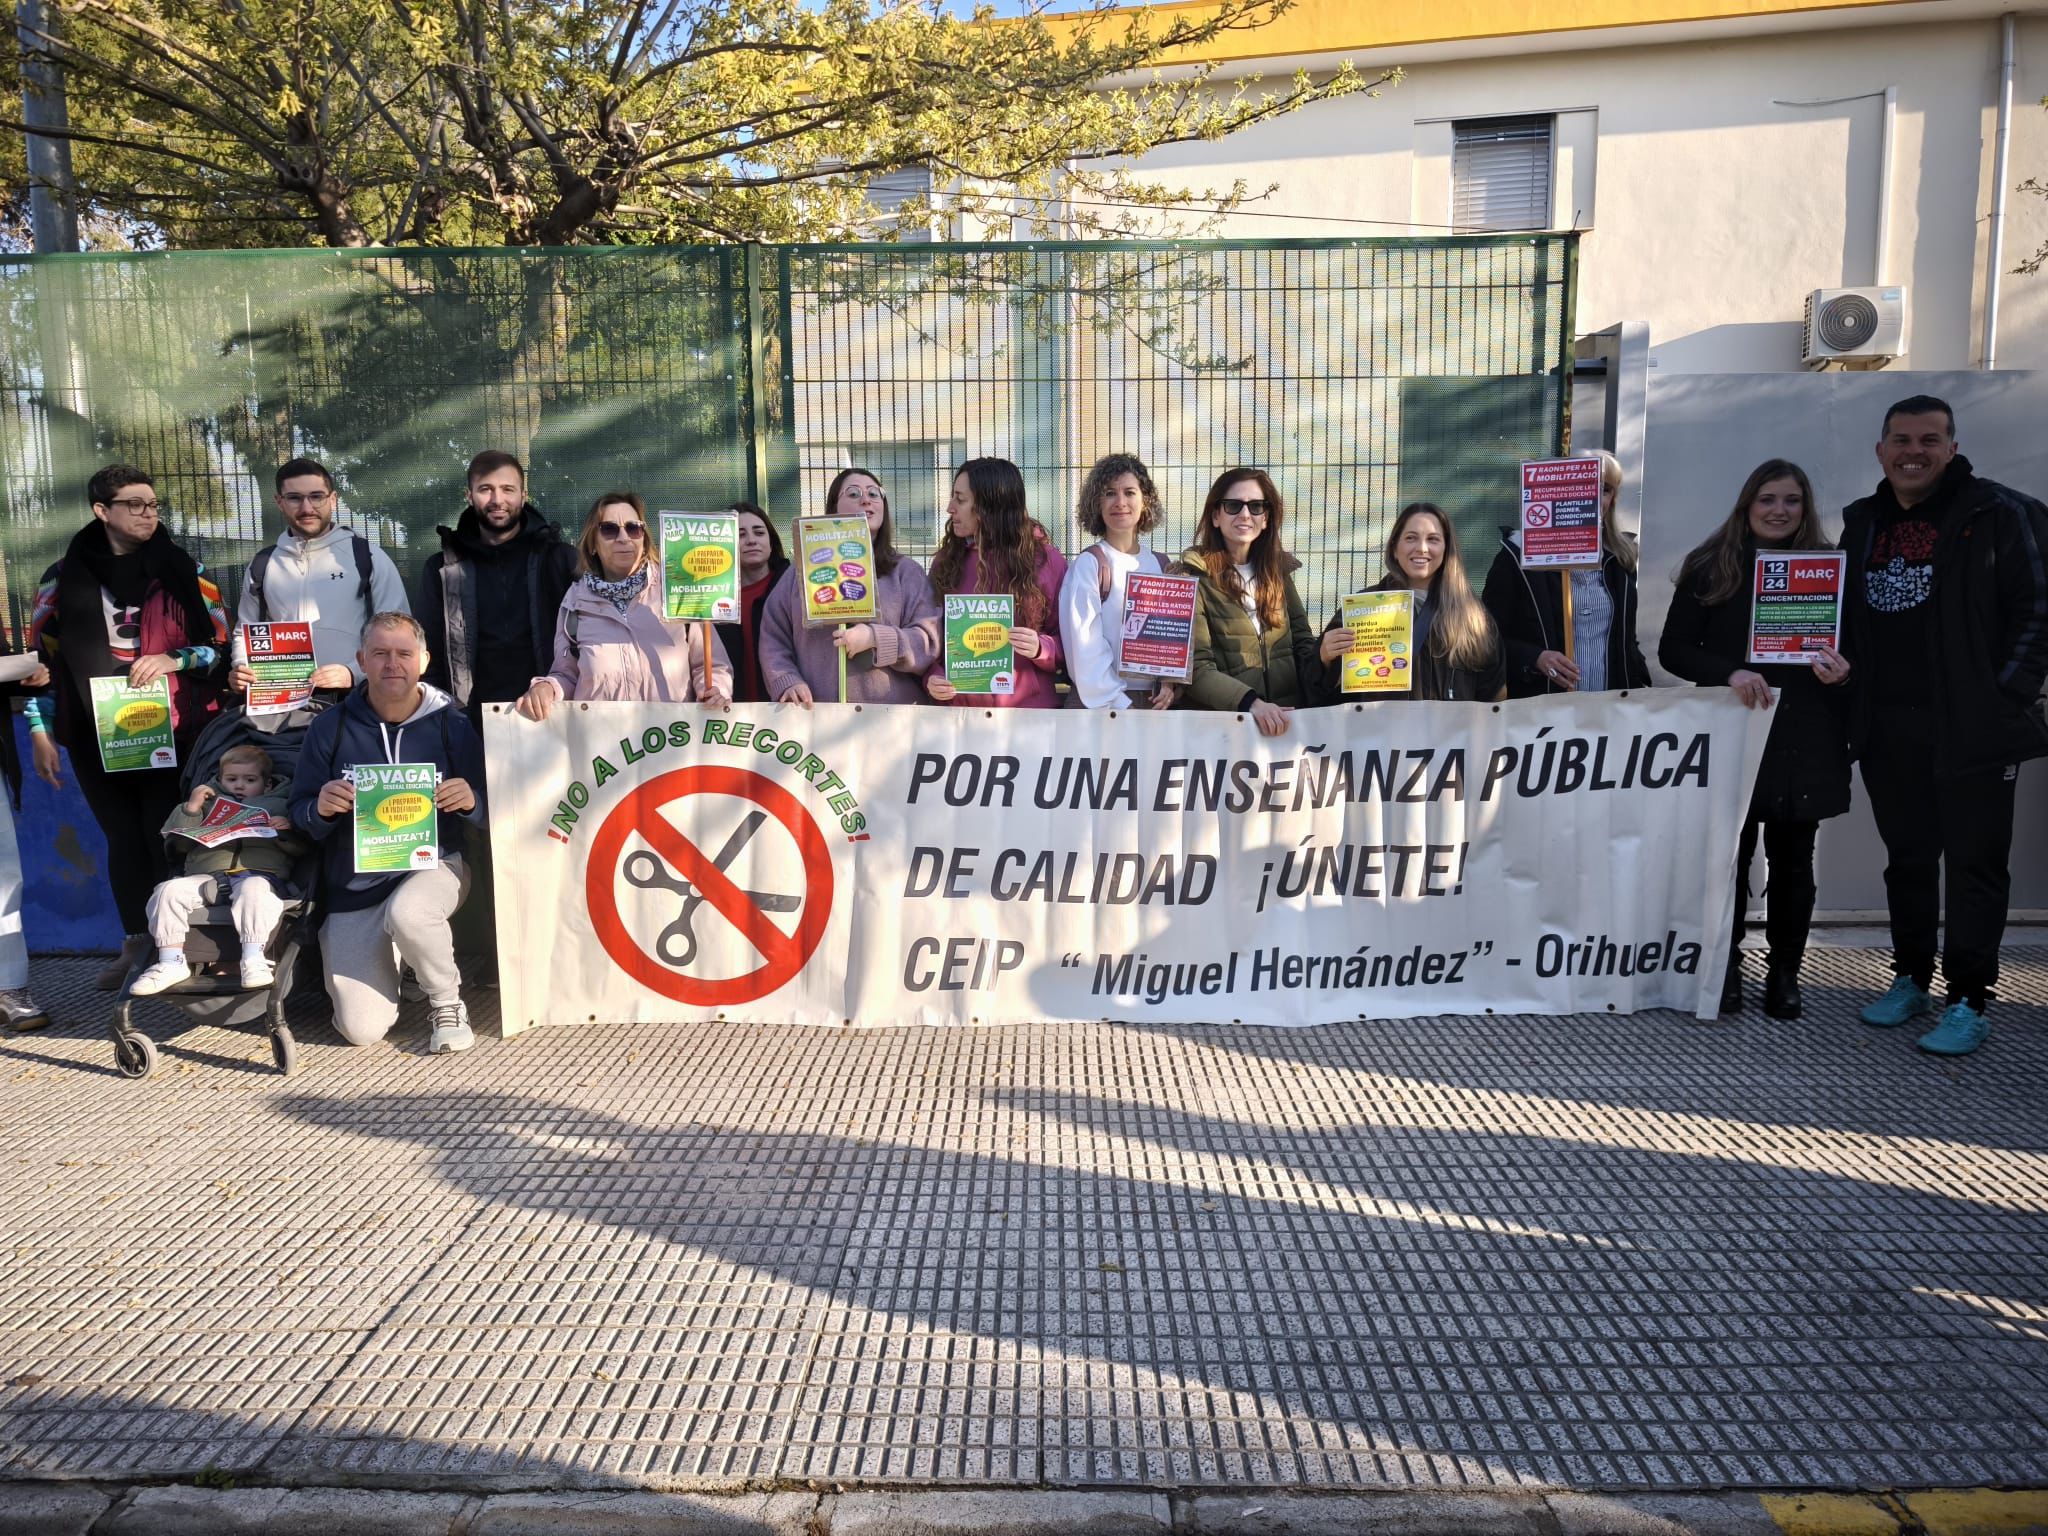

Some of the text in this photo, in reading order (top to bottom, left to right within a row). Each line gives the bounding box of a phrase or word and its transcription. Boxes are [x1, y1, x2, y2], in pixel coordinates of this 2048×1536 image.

[1526, 468, 1537, 482] 7
[1536, 469, 1598, 482] MOBILITZACIÓ
[1534, 492, 1568, 500] PLANTILLES
[1556, 512, 1596, 520] CONDICIONS
[664, 519, 680, 531] 31
[686, 522, 734, 537] VAGA
[697, 550, 724, 558] PREPAREM
[1768, 562, 1784, 573] 12
[1794, 569, 1835, 581] MARÇ
[1131, 580, 1142, 592] 7
[1142, 580, 1166, 588] RAONS
[1766, 578, 1786, 589] 24
[1140, 588, 1194, 598] MOBILITZACIÓ
[1760, 594, 1834, 602] CONCENTRACIONS
[966, 600, 1010, 613] VAGA
[947, 608, 963, 617] MARÇ
[1356, 620, 1378, 628] pèrdua
[252, 626, 268, 636] 12
[276, 632, 307, 642] MARÇ
[253, 640, 270, 650] 24
[1356, 640, 1384, 648] plantilles
[250, 654, 311, 662] CONCENTRACIONS
[106, 734, 168, 750] MOBILITZA'T!
[357, 768, 371, 780] 31
[907, 726, 1712, 814] POR UNA ENSEÑANZA PÚBLICA
[379, 768, 432, 784] VAGA
[592, 756, 618, 788] A
[620, 721, 690, 764] LOS
[702, 719, 870, 842] RECORTES!
[356, 778, 377, 788] MARÇ
[392, 797, 422, 806] PREPAREM
[390, 805, 422, 813] INDEFINIDA
[394, 814, 408, 822] MAIG
[362, 830, 430, 846] MOBILITZA'T!
[904, 835, 1469, 913] DE CALIDAD ¡ÚNETE!
[903, 936, 1025, 992] CEIP
[1090, 952, 1238, 1006] Miguel
[1536, 930, 1702, 978] Orihuela
